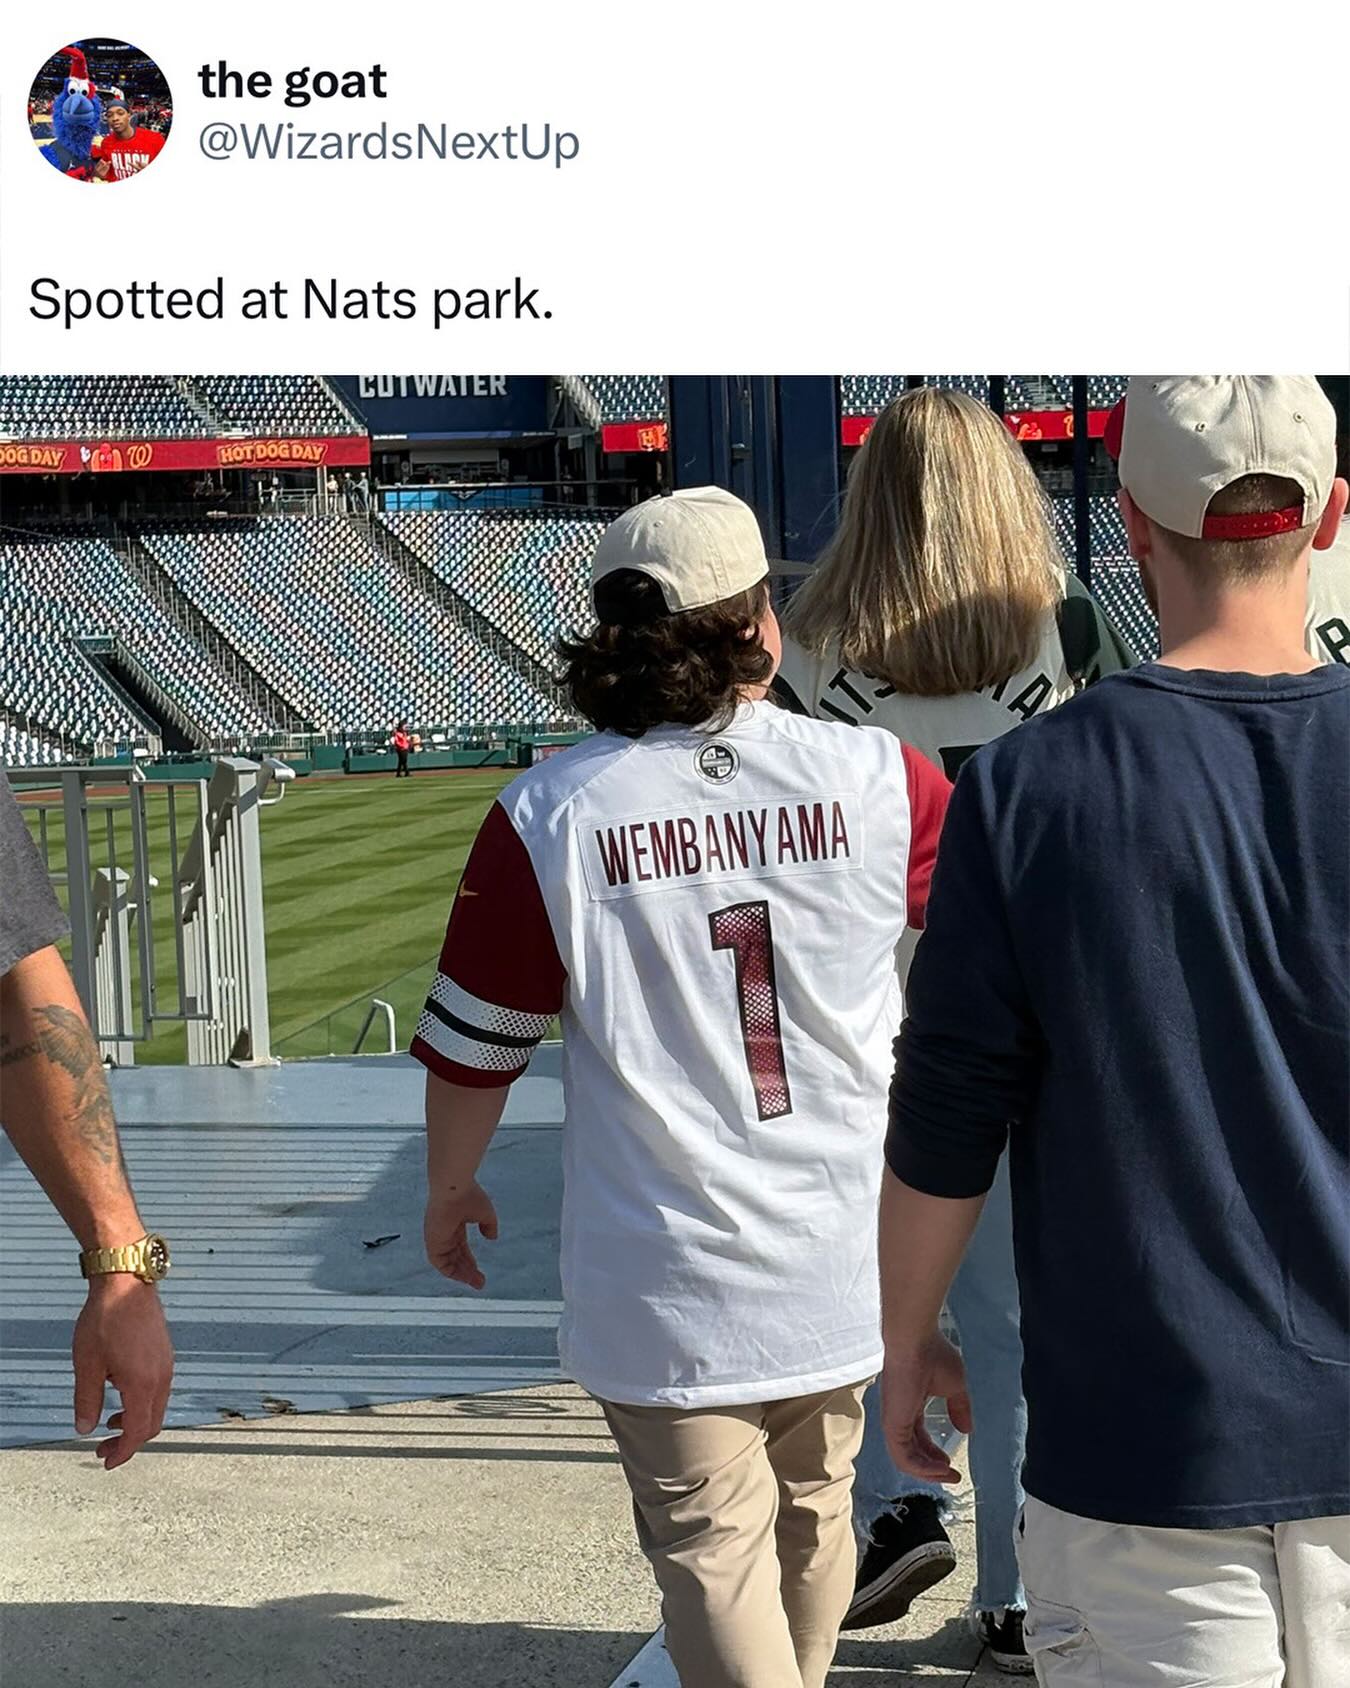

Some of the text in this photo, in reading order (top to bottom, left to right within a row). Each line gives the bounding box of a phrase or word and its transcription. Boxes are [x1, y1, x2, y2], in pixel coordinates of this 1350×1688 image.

[31, 448, 63, 467] DAY
[220, 443, 324, 465] HOT DOG DAY
[595, 801, 850, 887] WEMBANYAMA
[708, 900, 793, 1122] 1
